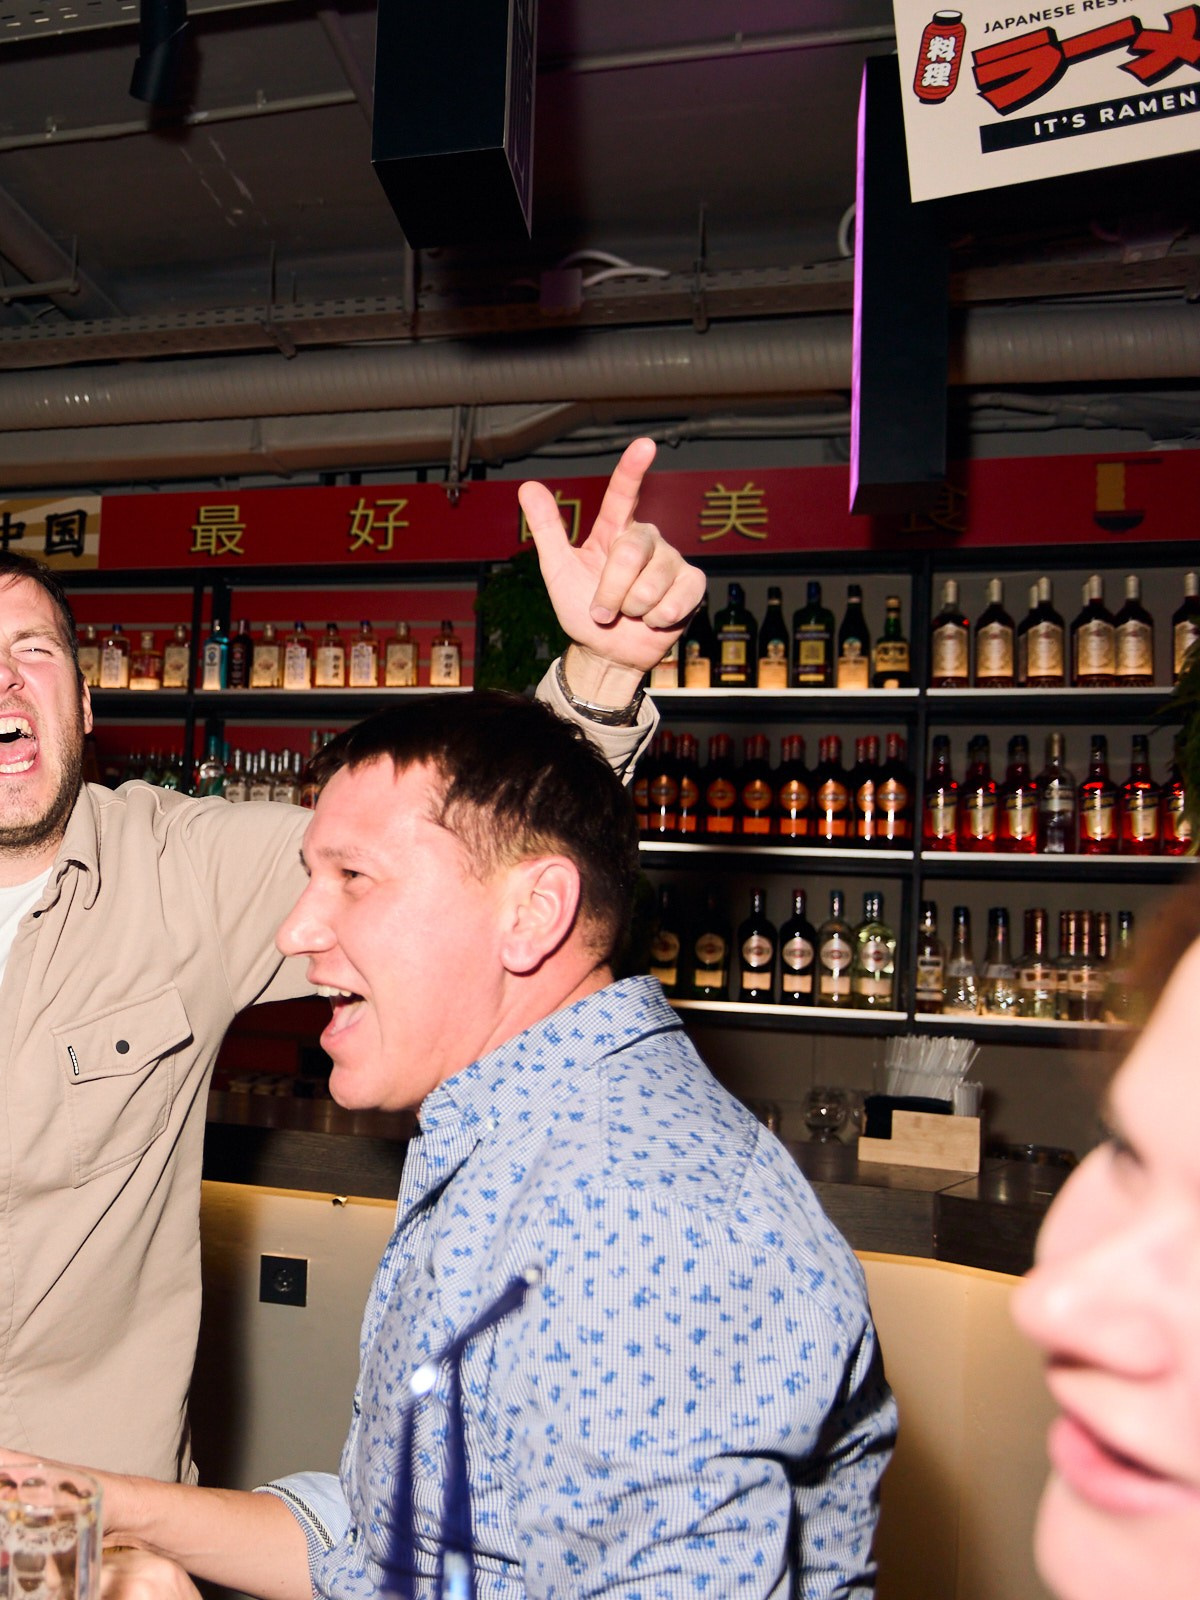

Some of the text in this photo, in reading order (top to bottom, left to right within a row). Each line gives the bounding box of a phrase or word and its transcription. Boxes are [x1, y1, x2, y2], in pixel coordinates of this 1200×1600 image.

[984, 0, 1134, 34] JAPANESE RES
[921, 36, 956, 87] 料理
[1033, 90, 1197, 136] IT'S RAMEN
